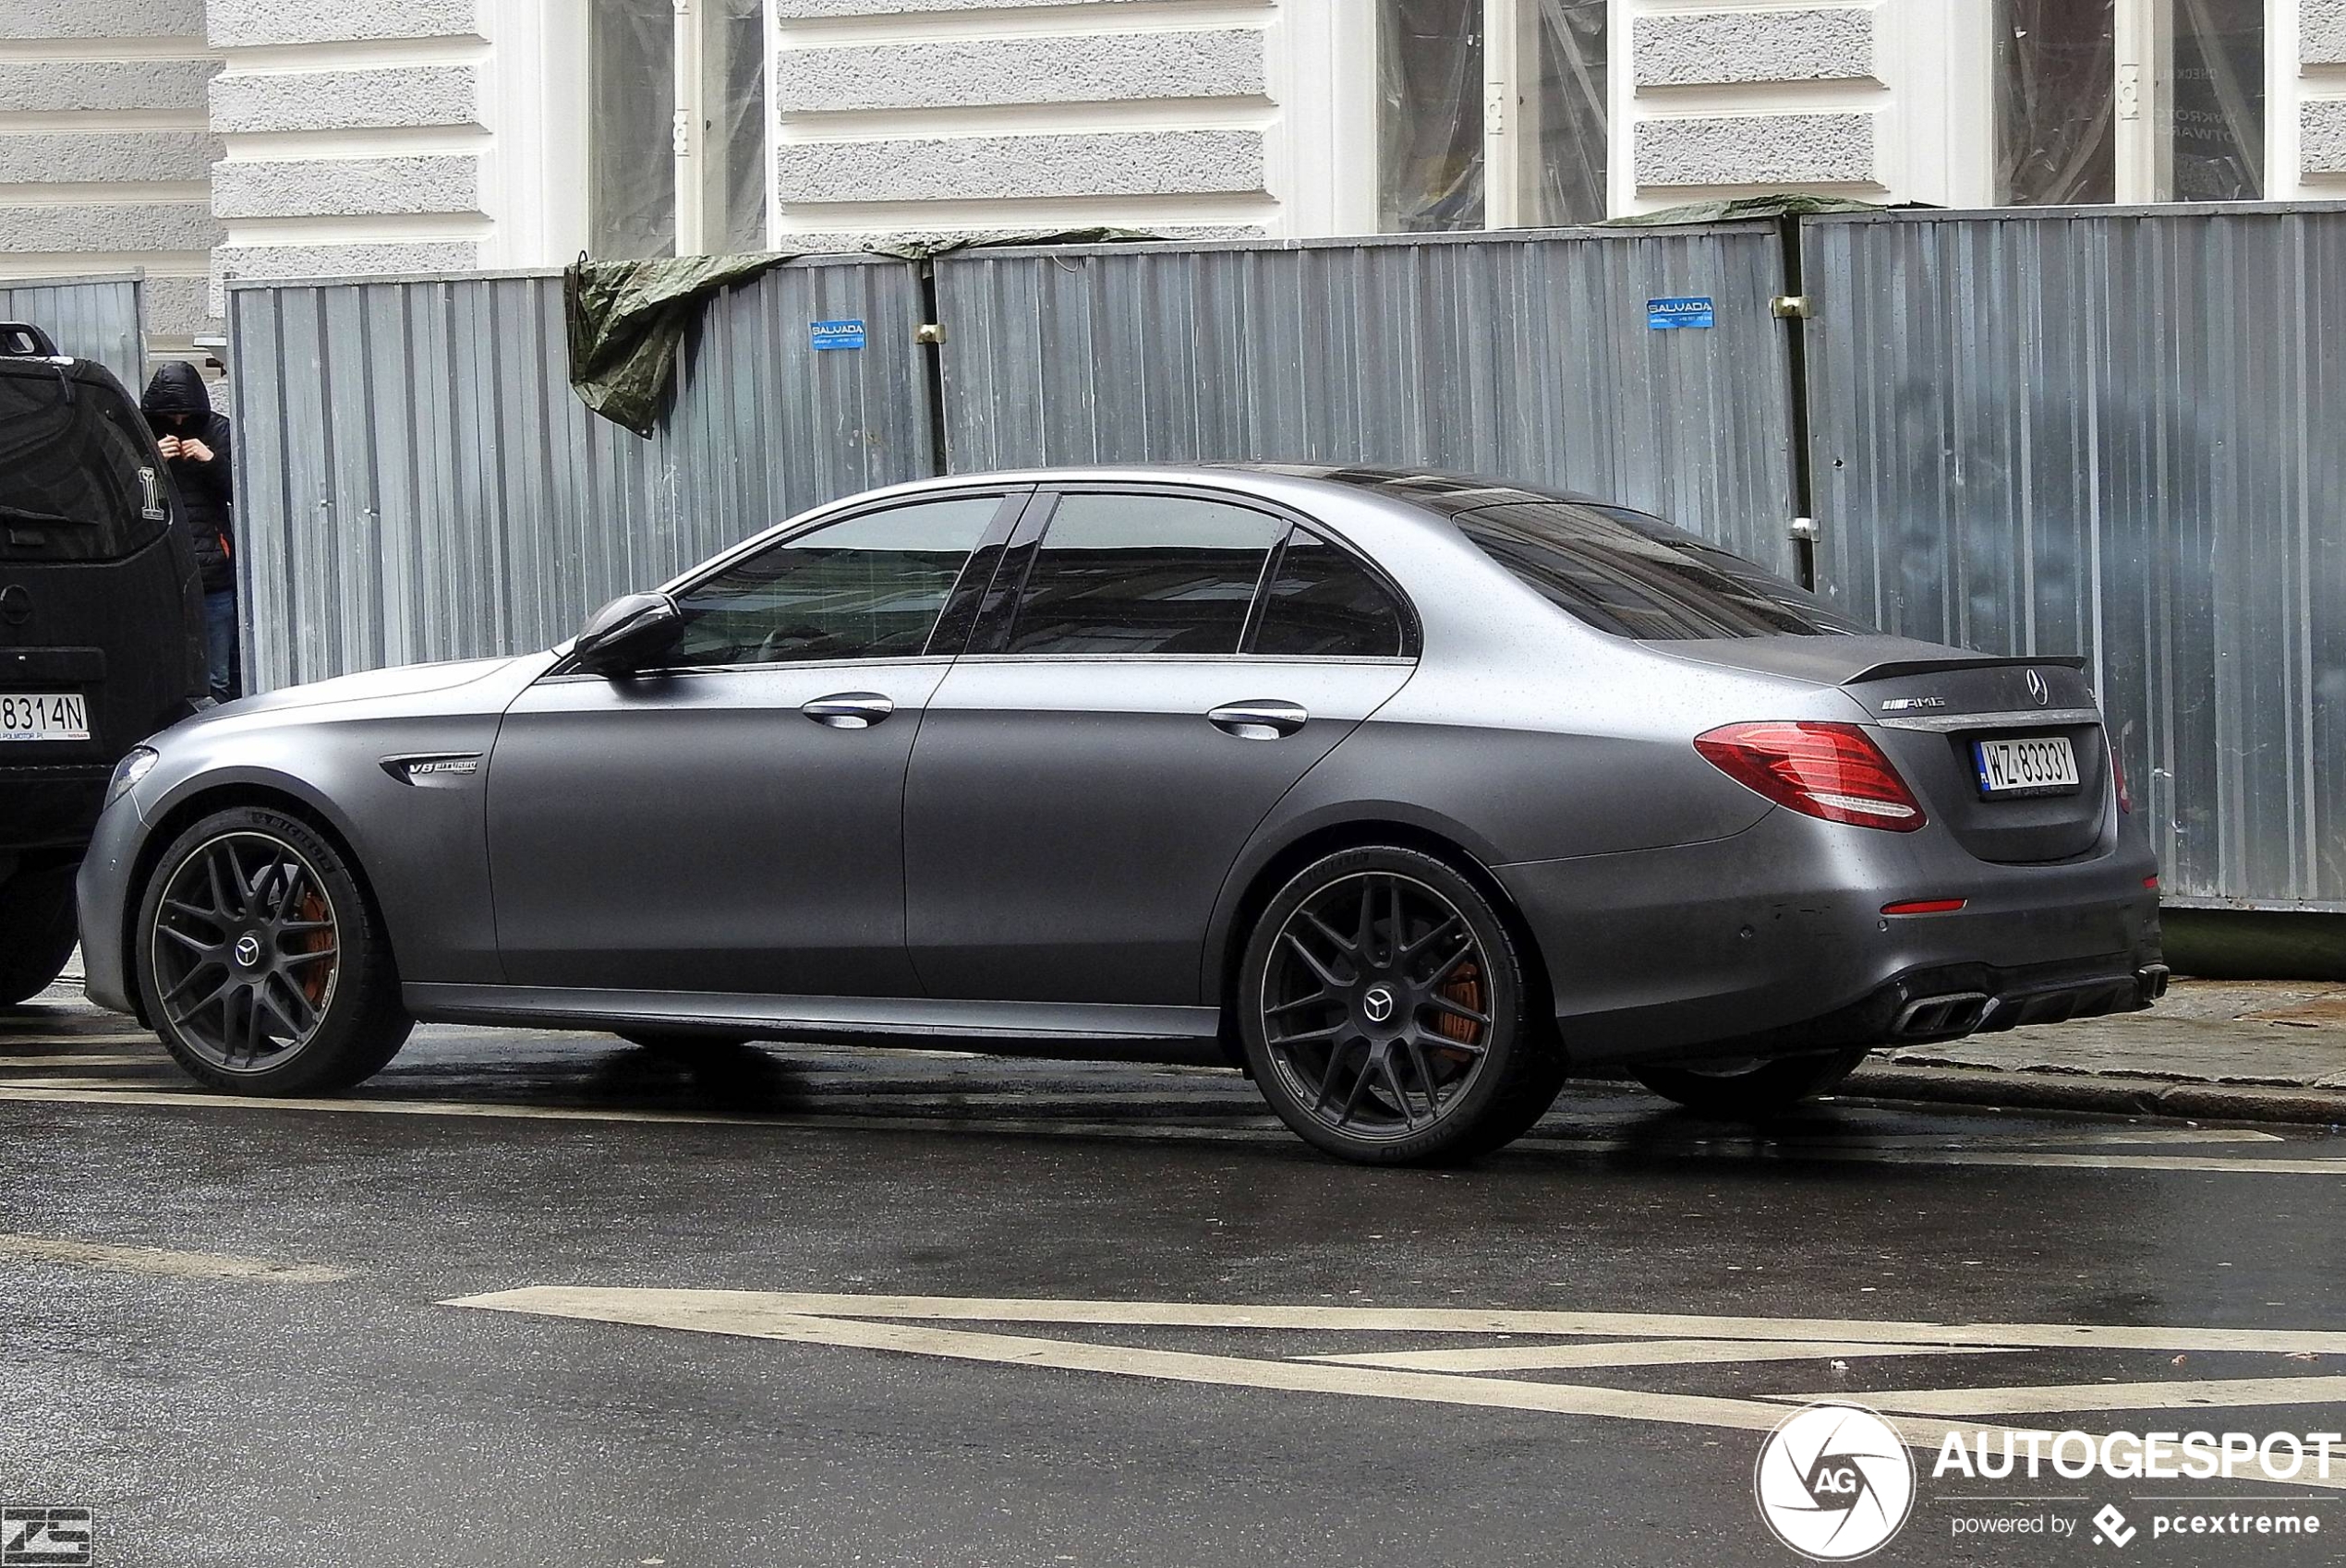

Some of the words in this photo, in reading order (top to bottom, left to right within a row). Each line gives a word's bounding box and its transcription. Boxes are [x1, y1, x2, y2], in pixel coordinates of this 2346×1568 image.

[1648, 302, 1712, 314] SALVADA
[812, 324, 864, 335] SALVADA
[1907, 696, 1946, 708] AMG
[3, 697, 83, 730] 8314N
[2018, 742, 2071, 782] 8333Y
[409, 764, 434, 774] V8
